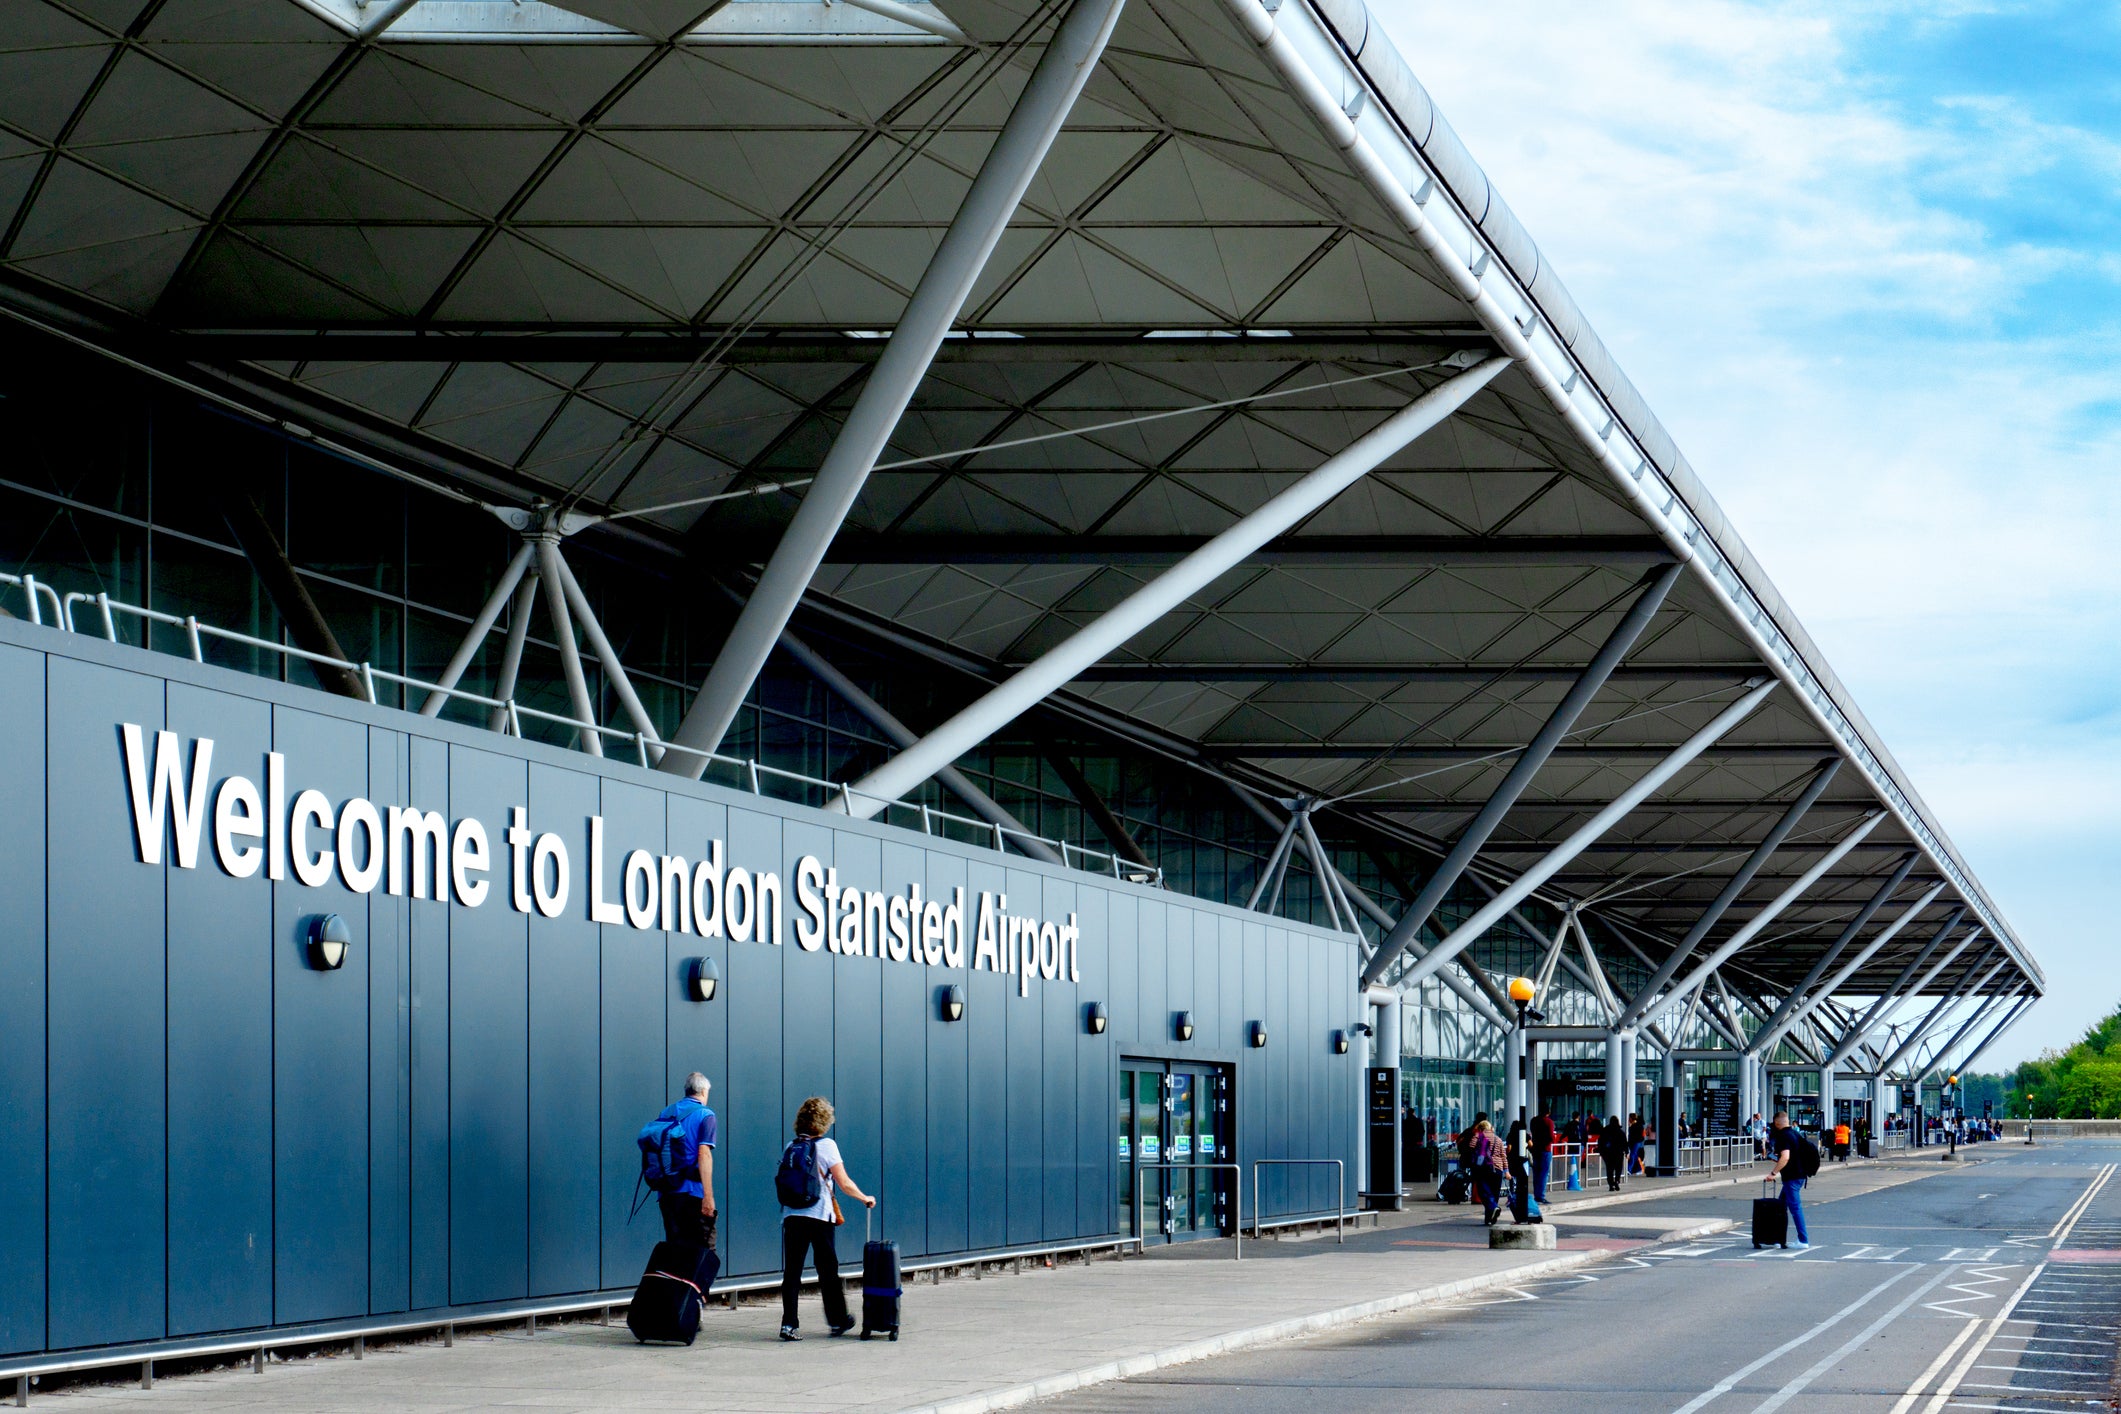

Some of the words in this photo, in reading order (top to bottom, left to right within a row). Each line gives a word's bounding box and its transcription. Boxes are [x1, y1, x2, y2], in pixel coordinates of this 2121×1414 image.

[122, 722, 491, 908] Welcome
[508, 805, 570, 919] to
[591, 815, 783, 946] London
[796, 854, 965, 969] Stansted
[973, 890, 1080, 998] Airport
